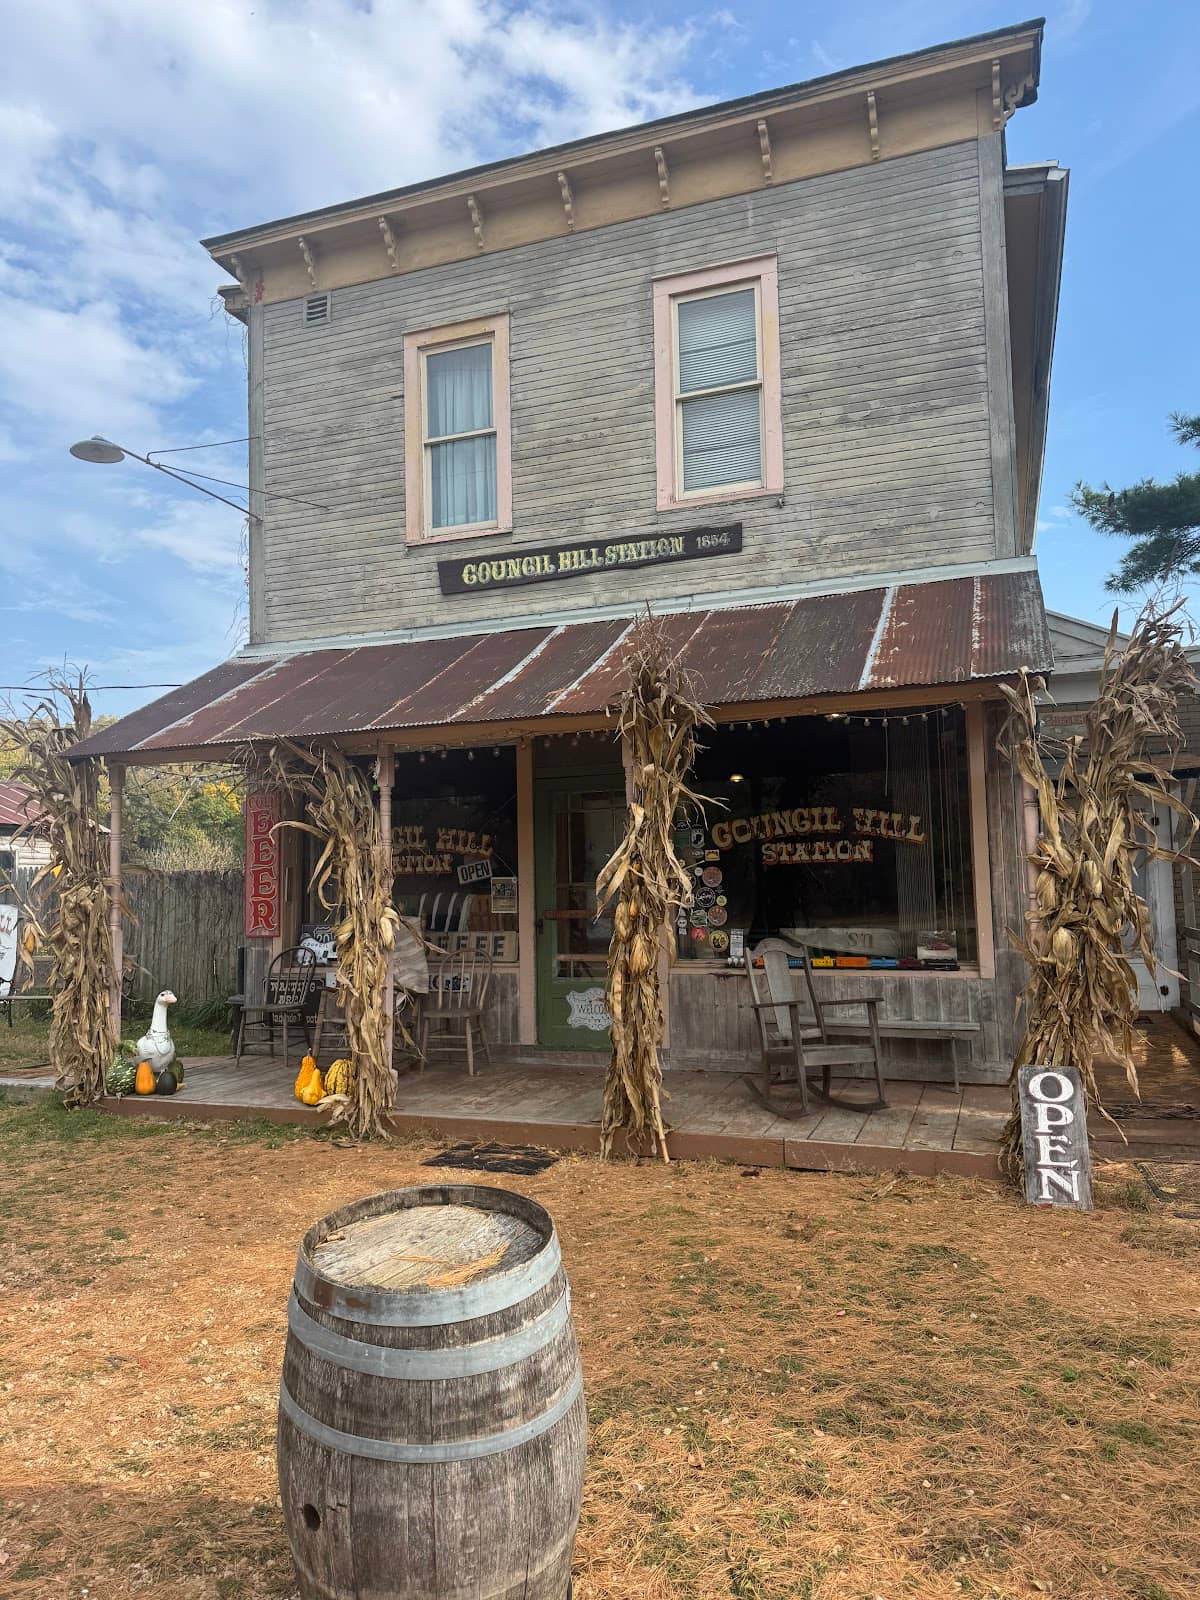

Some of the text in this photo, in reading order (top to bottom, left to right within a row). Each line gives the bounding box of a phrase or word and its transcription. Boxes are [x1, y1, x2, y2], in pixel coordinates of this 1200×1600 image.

[462, 532, 731, 585] COUNCIL HILL STATION 1854
[711, 807, 842, 850] COUNCIL
[852, 807, 928, 846] HILL
[761, 840, 874, 864] STATION
[250, 810, 278, 931] BEER
[460, 862, 491, 882] OPEN
[1028, 1071, 1081, 1203] OPEN
